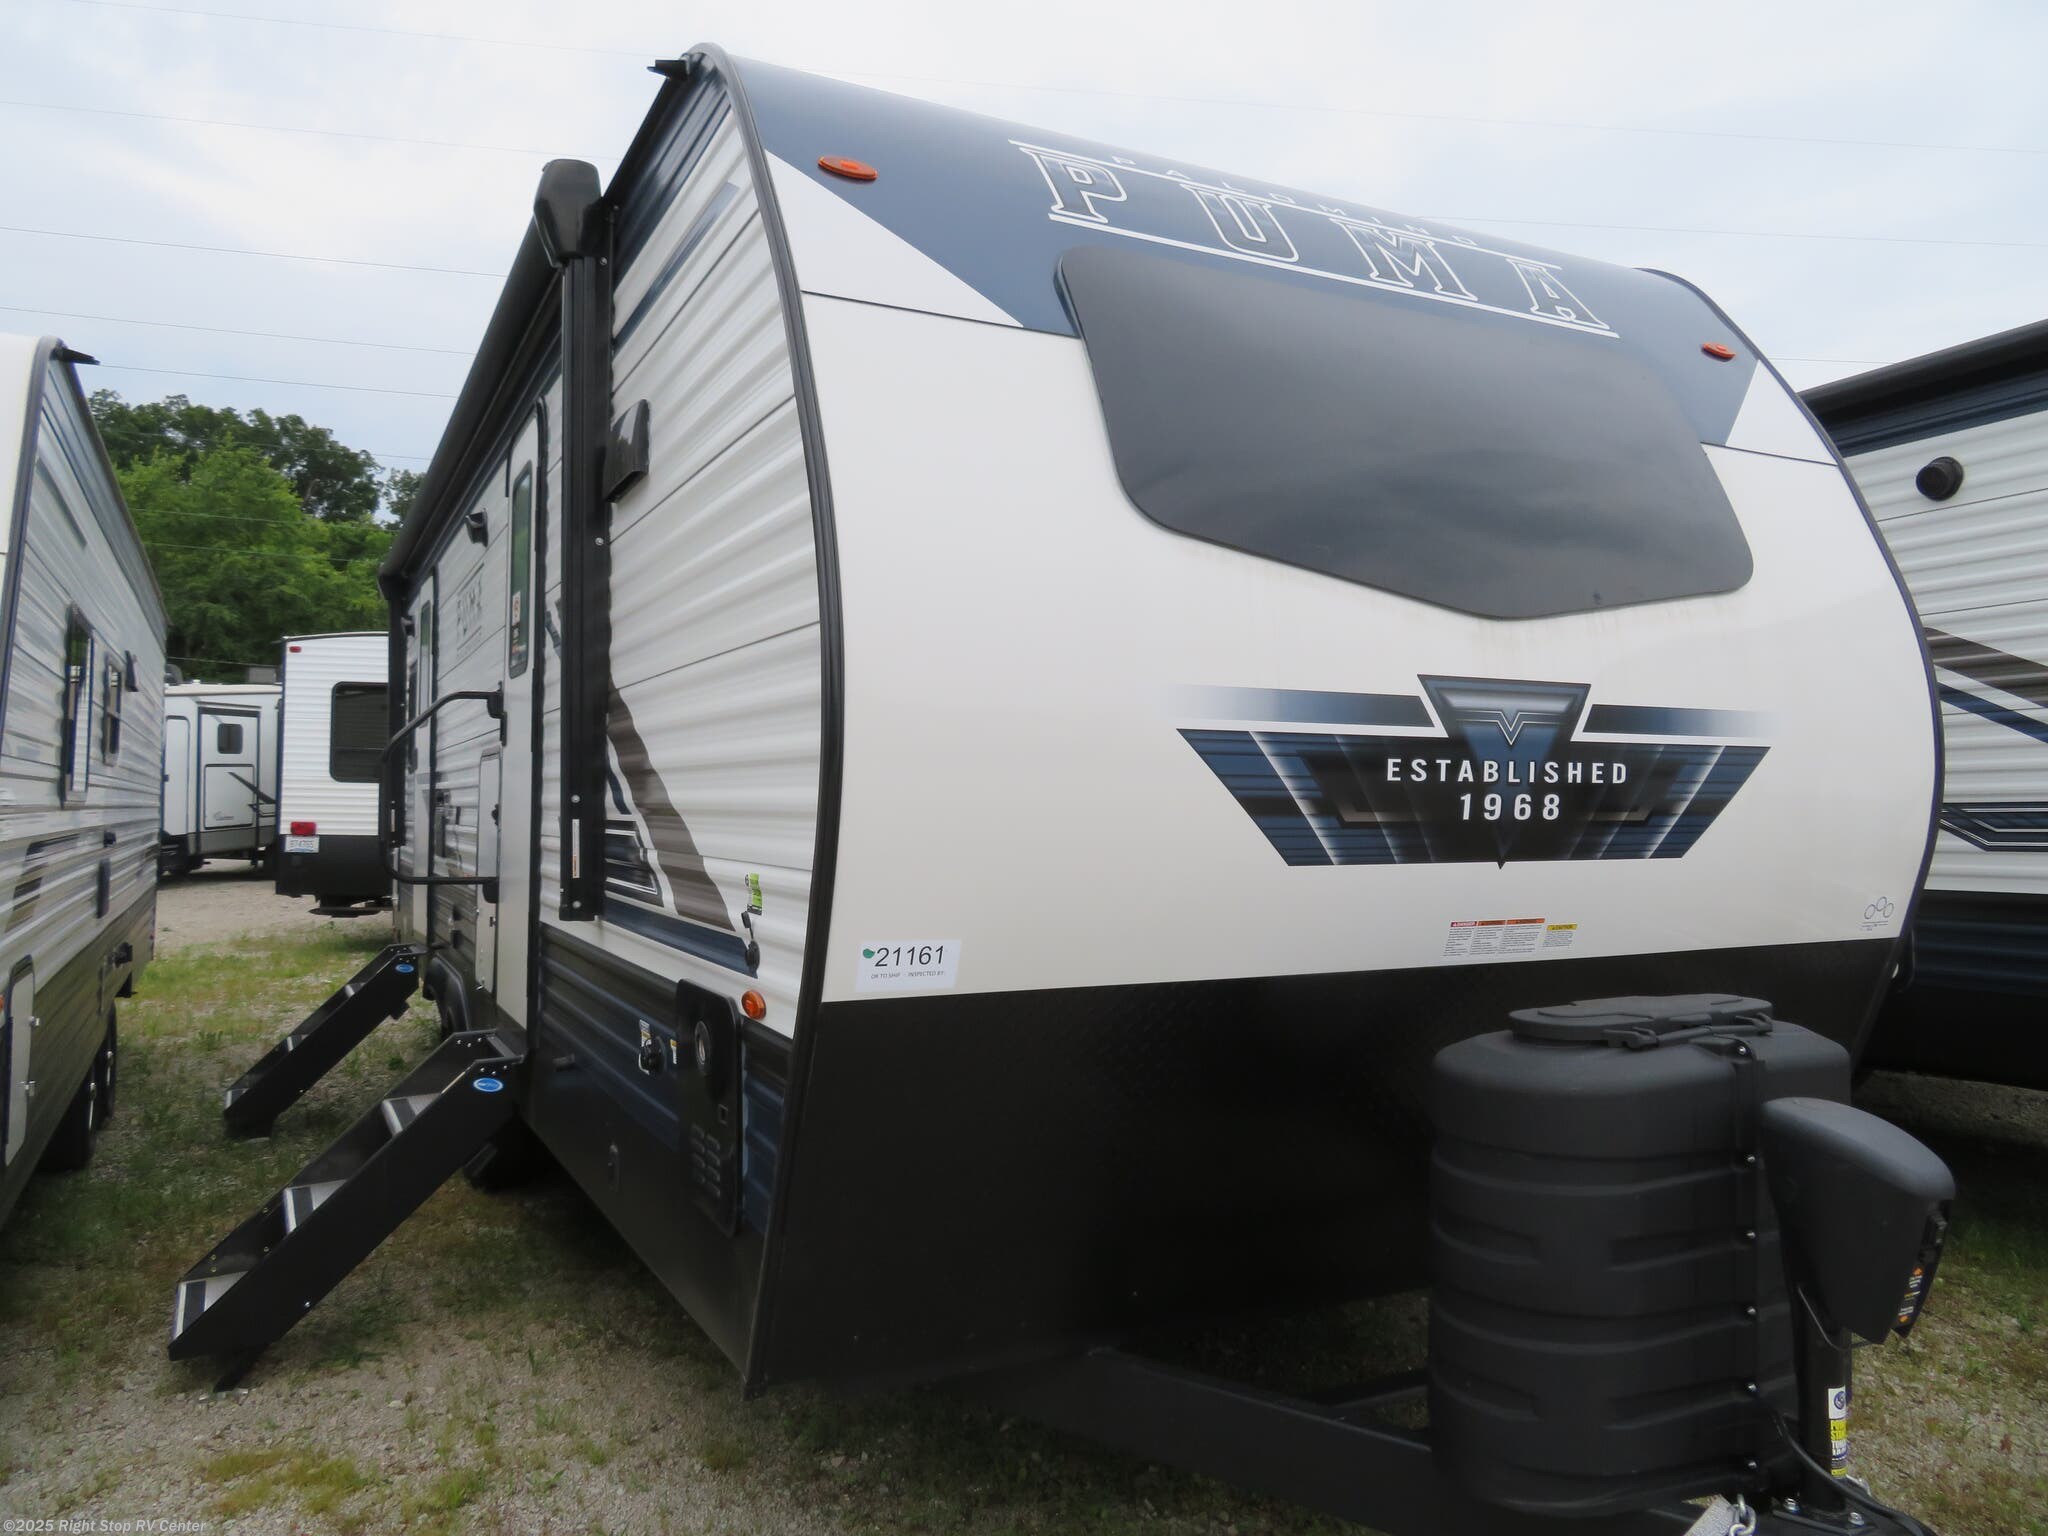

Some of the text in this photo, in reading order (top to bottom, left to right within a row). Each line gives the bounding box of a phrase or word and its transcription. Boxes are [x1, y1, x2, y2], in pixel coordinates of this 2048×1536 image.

[1019, 146, 1611, 330] PUMA
[1387, 758, 1627, 784] ESTABLISHED
[1460, 793, 1560, 821] 1968
[874, 945, 944, 967] 21161
